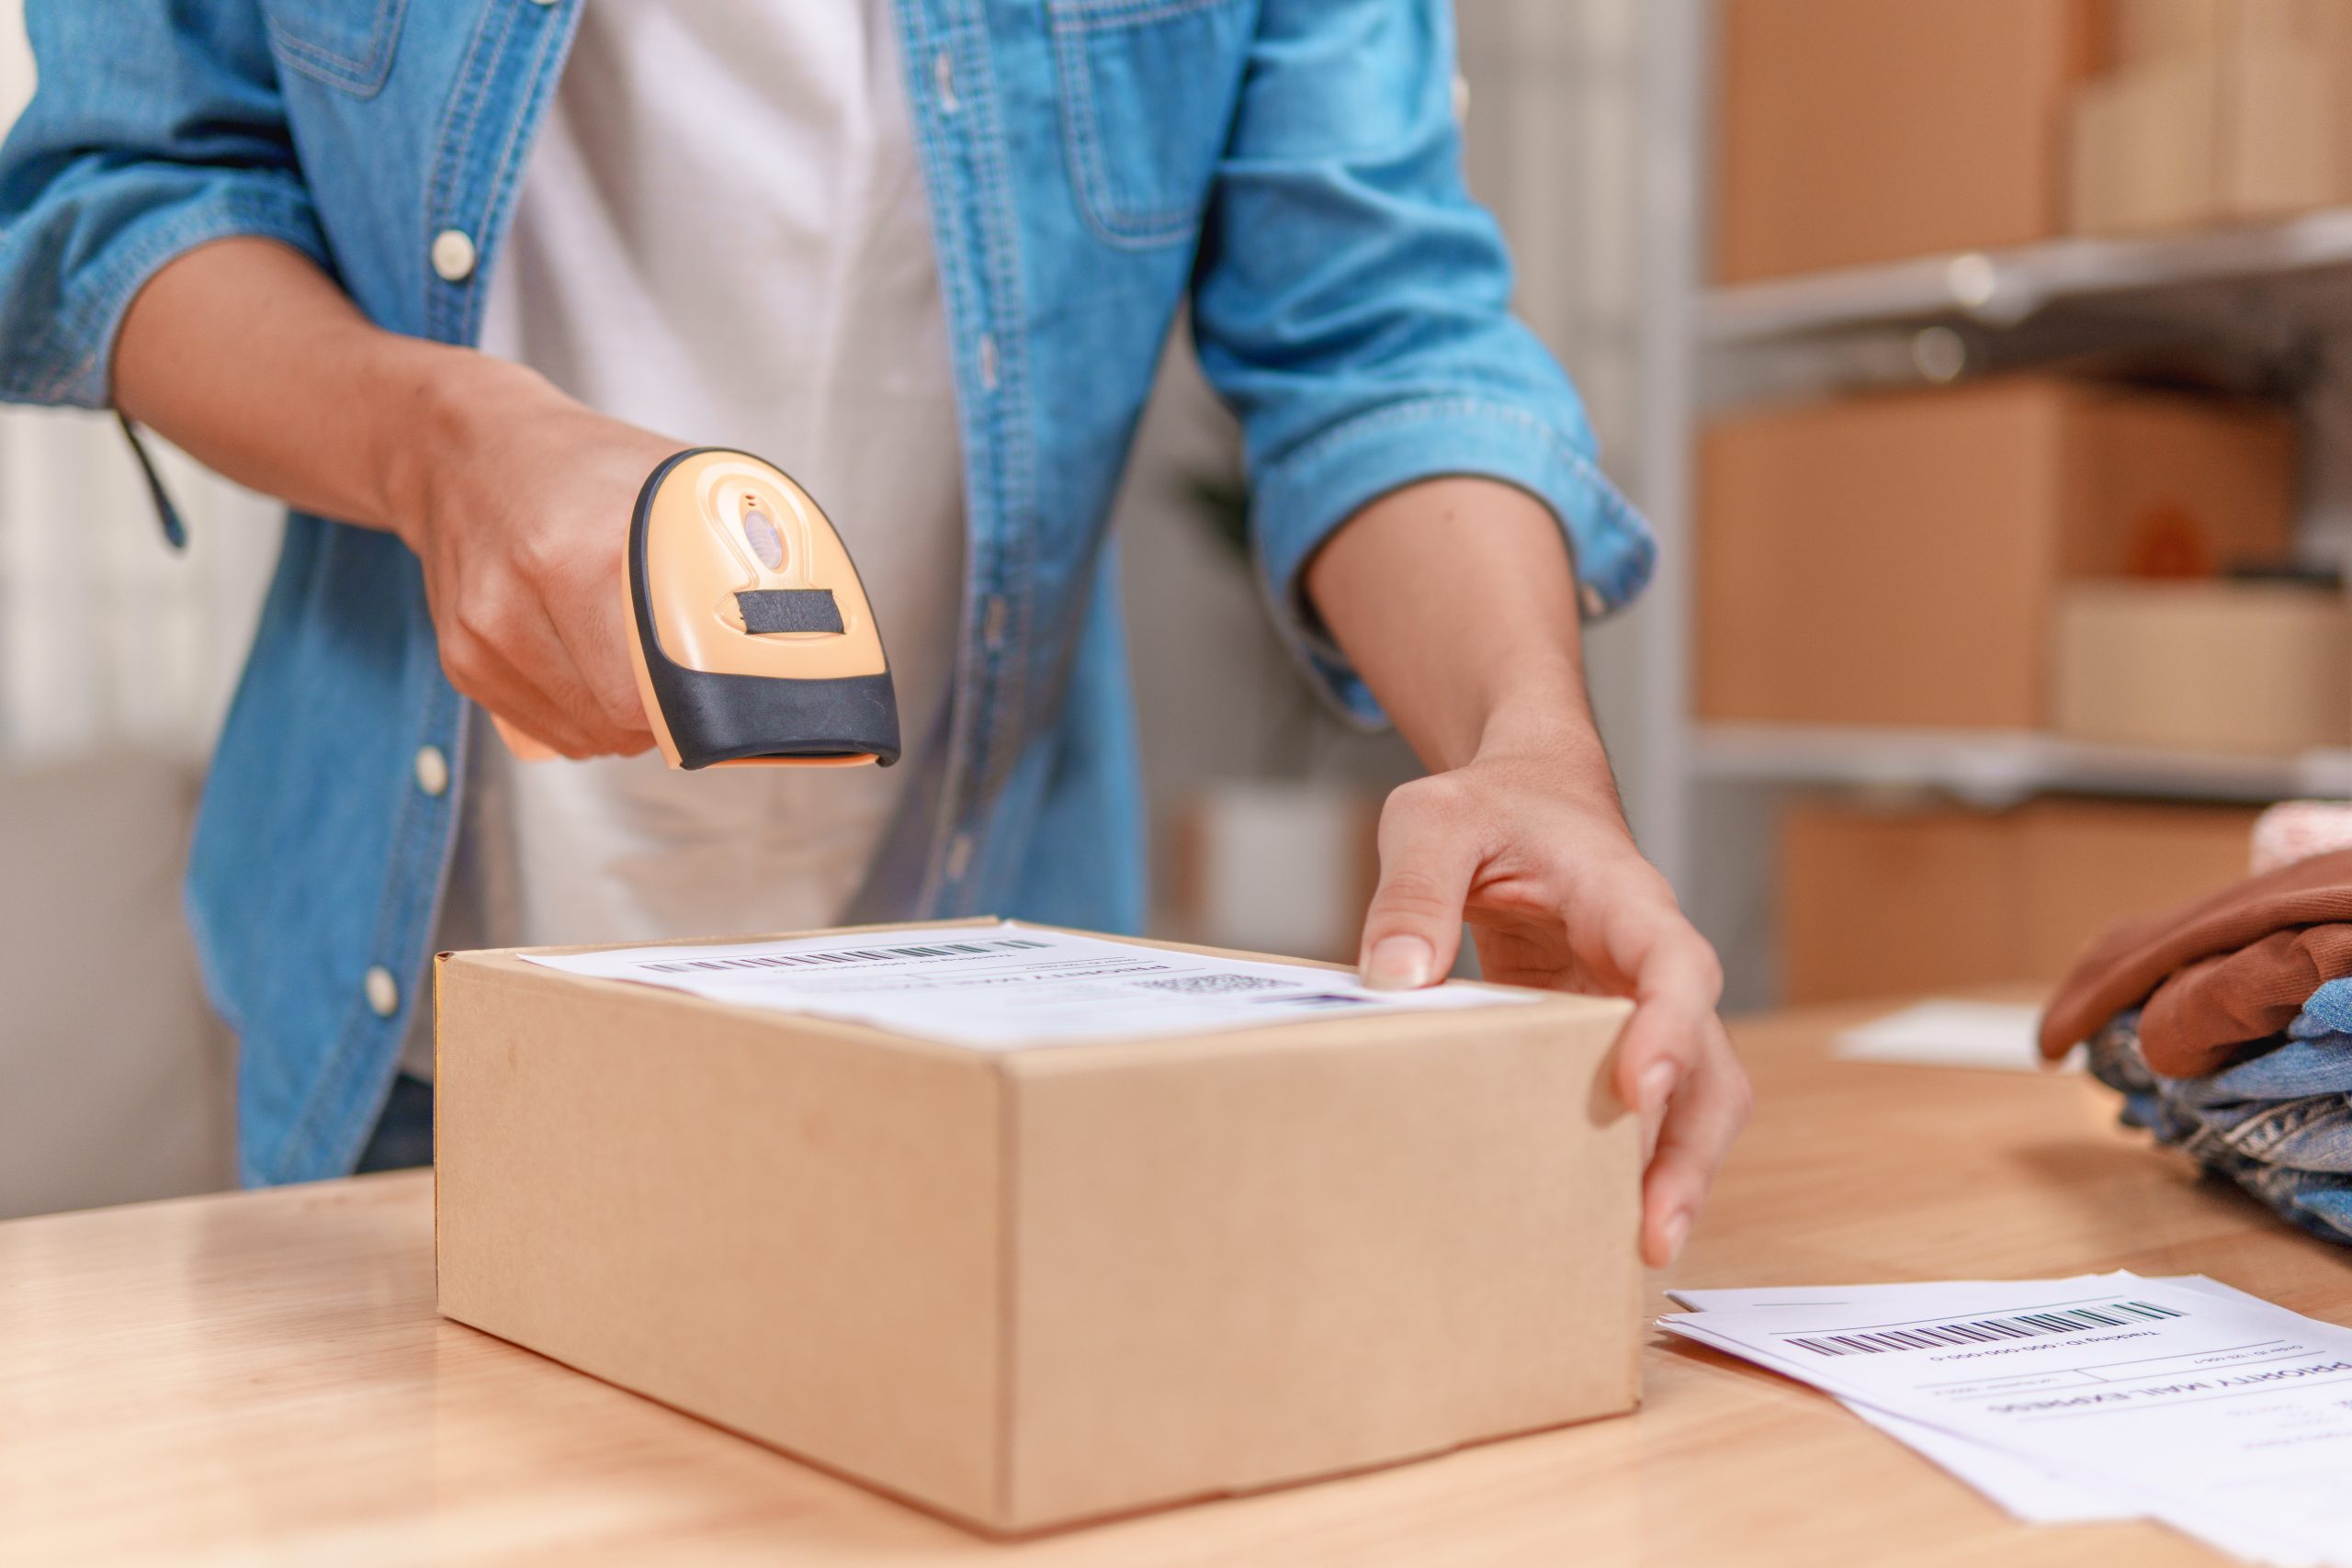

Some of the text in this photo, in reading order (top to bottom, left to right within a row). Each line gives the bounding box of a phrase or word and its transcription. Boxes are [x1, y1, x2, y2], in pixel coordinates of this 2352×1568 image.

[2085, 1330, 2162, 1344] Tracking
[2217, 1361, 2352, 1387] PRIORITY
[2128, 1382, 2213, 1397] MAIL
